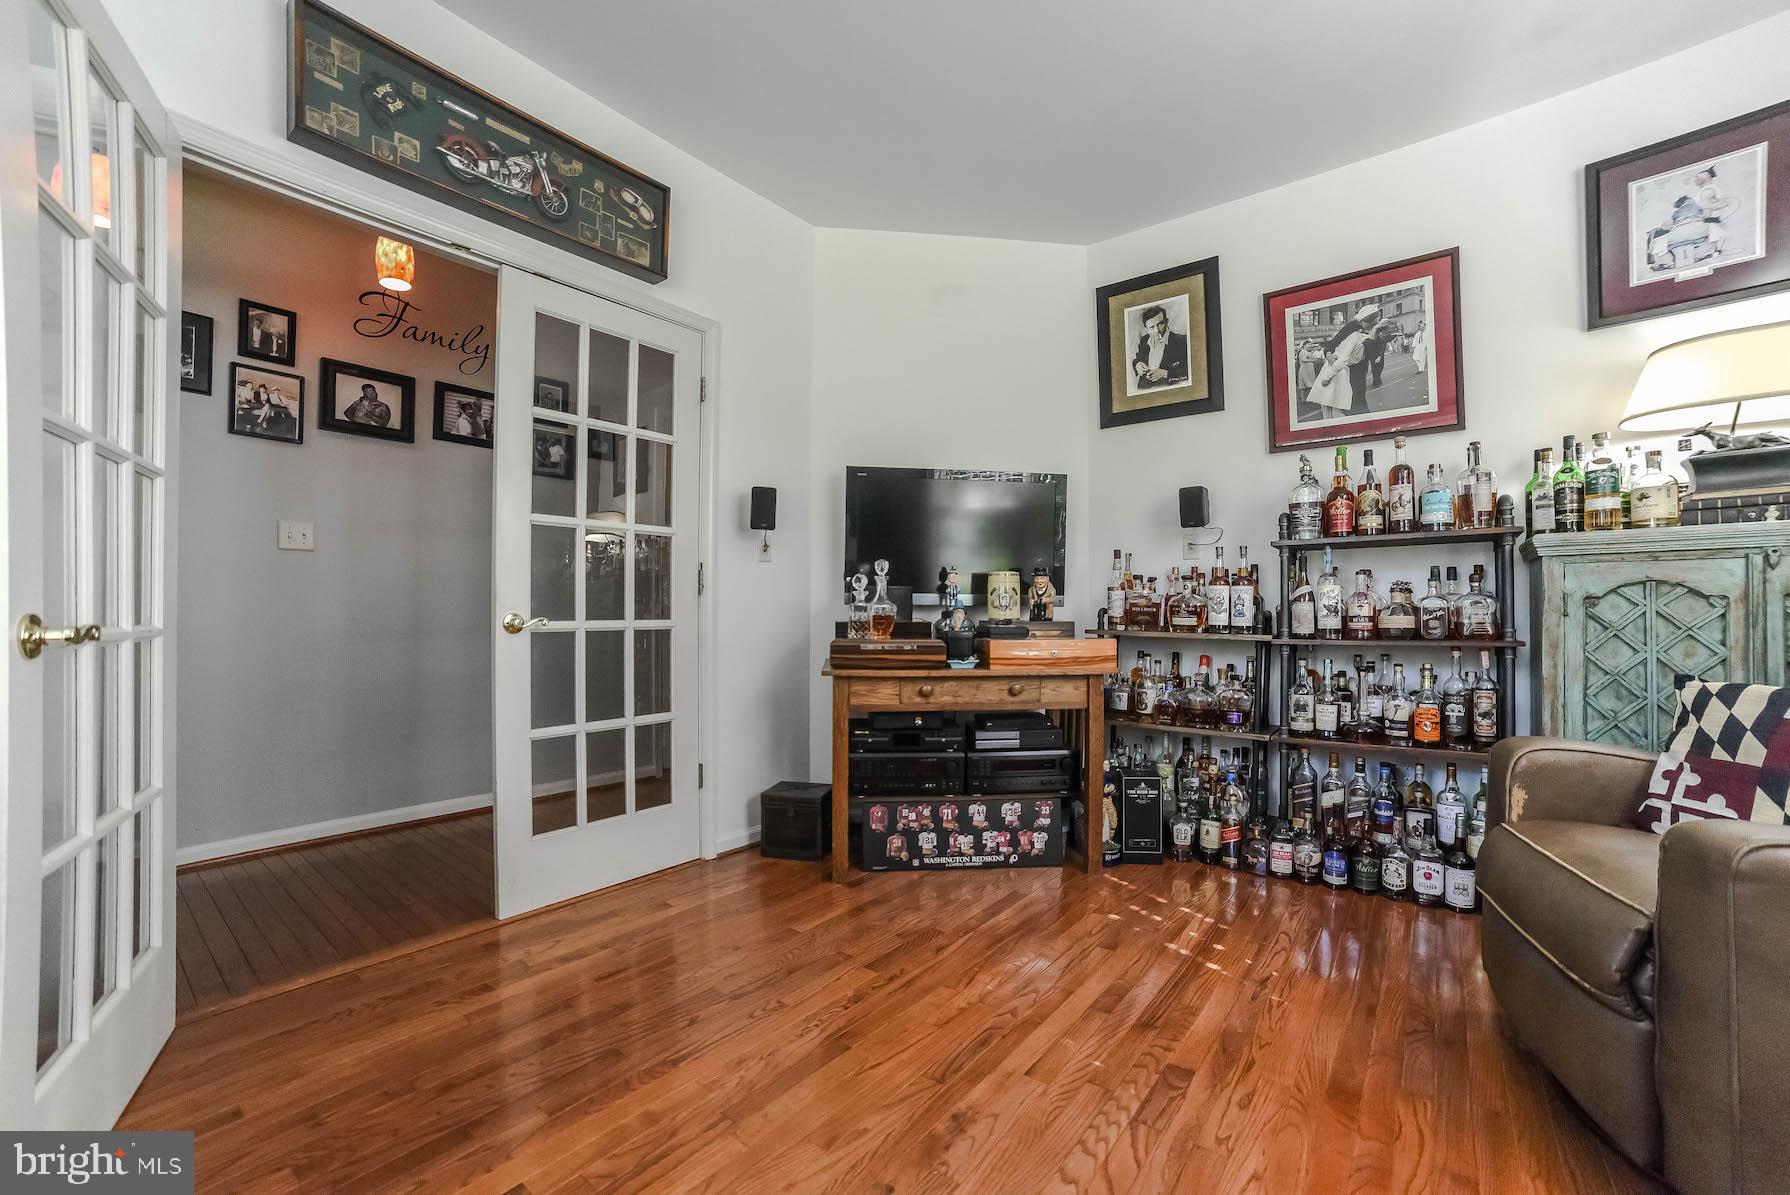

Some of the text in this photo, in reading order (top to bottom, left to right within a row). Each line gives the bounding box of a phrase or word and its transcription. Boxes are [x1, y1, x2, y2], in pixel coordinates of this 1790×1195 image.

[353, 289, 491, 375] Family
[1554, 482, 1582, 490] JAMESON
[976, 808, 985, 817] 44
[1041, 806, 1050, 815] 33
[1176, 833, 1188, 841] ELK
[923, 856, 970, 864] WASHINGTON
[971, 855, 1005, 863] REDSKINS
[1425, 865, 1440, 875] BEAM
